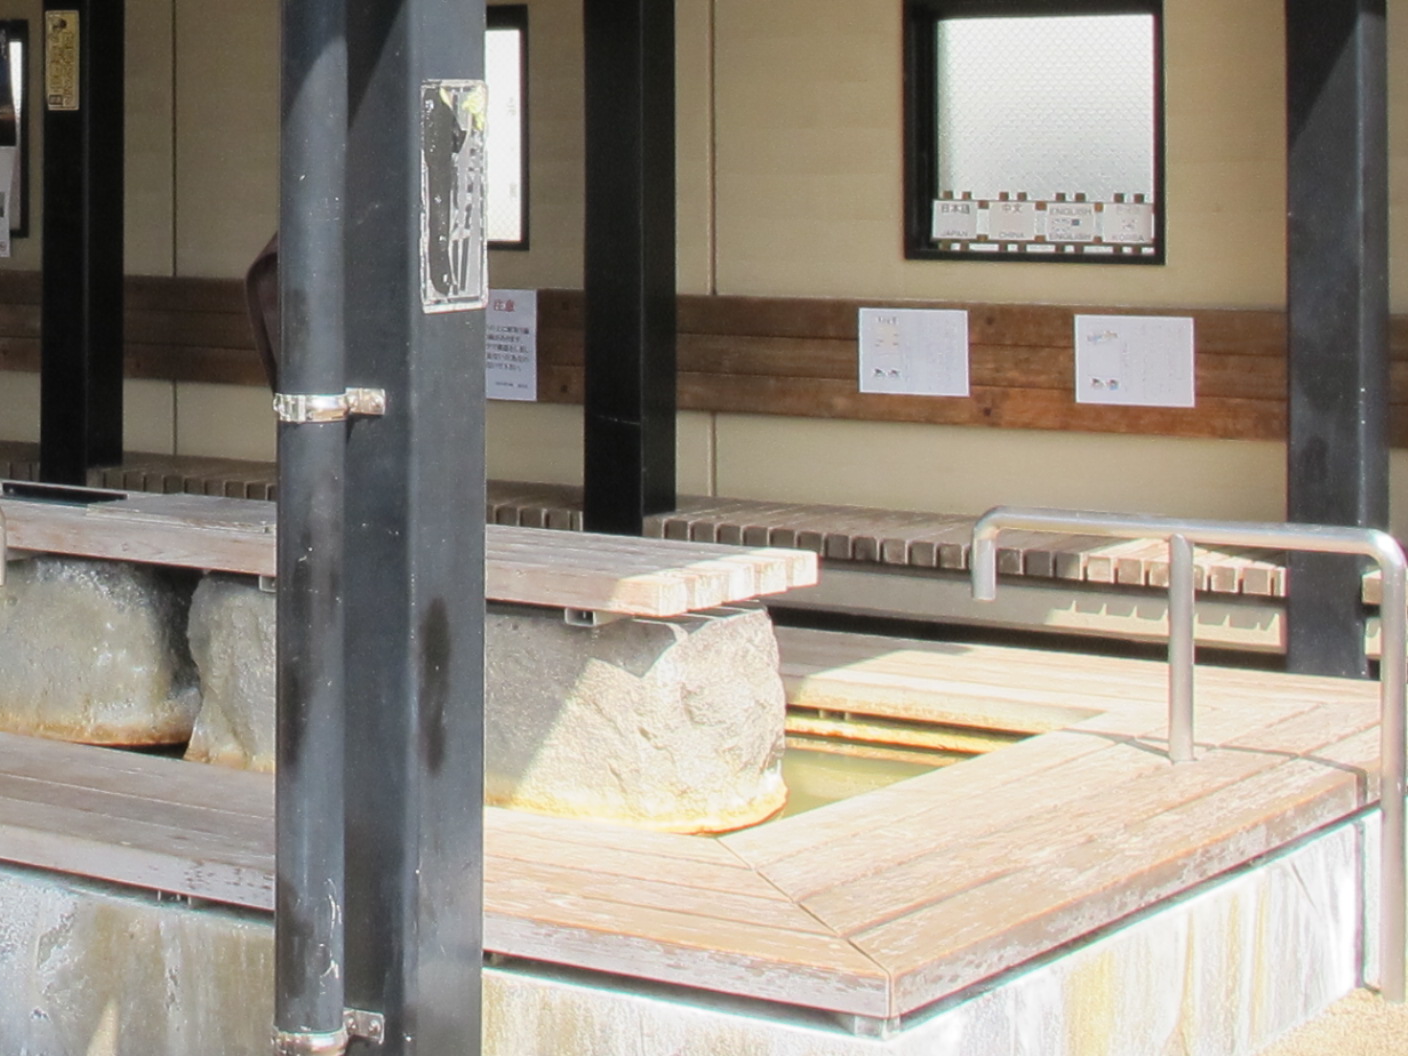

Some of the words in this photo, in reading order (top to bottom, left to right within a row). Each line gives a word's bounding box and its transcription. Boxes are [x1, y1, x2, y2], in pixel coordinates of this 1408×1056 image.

[941, 203, 970, 215] 日本語
[1001, 203, 1024, 215] 中文
[1049, 207, 1092, 216] ENGLISH
[943, 230, 970, 238] JAPAN
[998, 231, 1025, 239] CHINA
